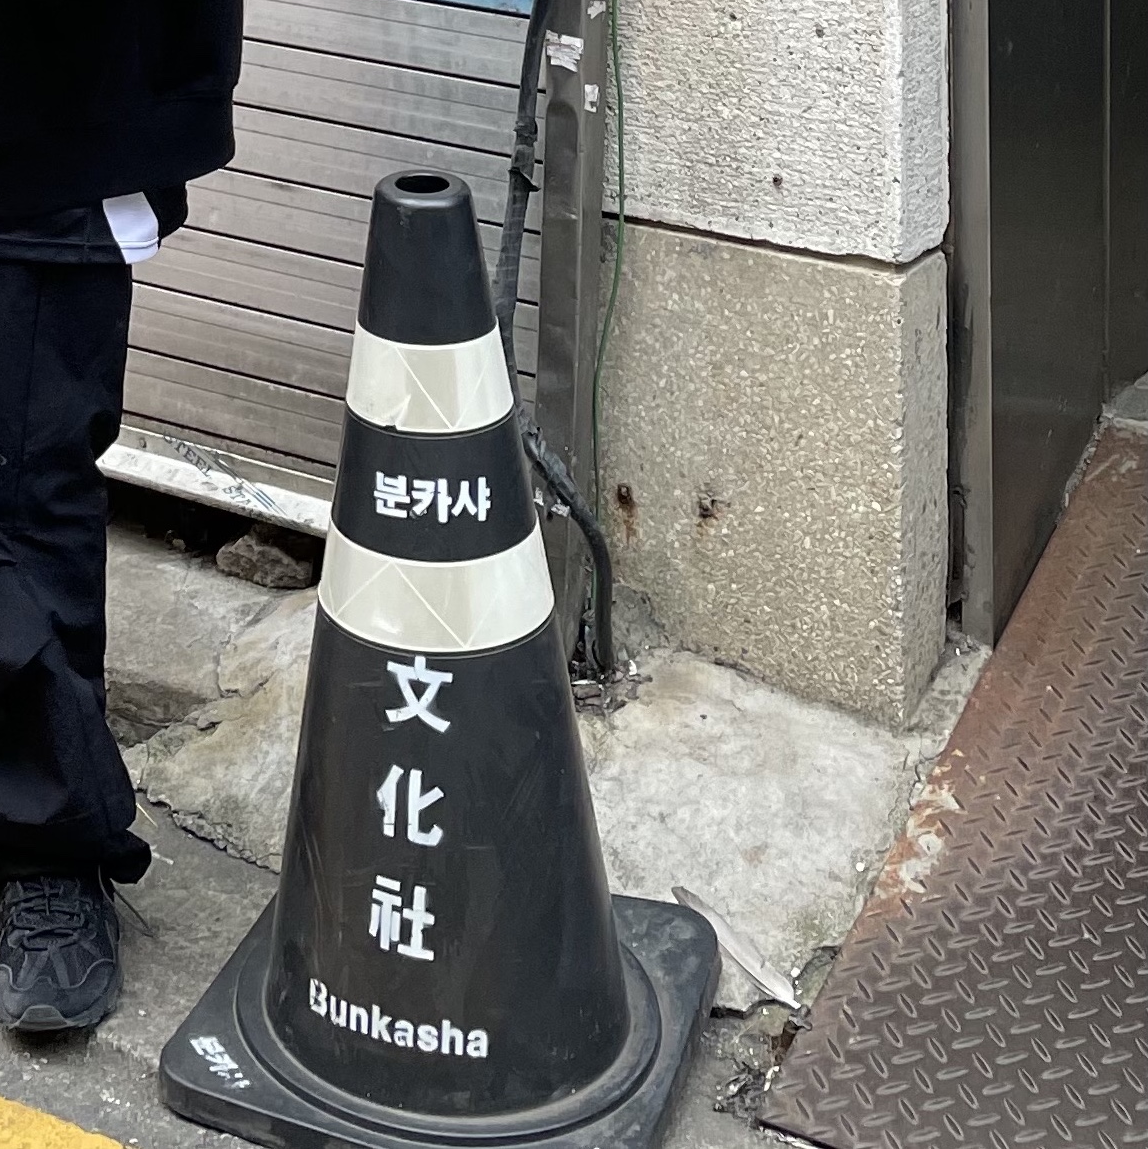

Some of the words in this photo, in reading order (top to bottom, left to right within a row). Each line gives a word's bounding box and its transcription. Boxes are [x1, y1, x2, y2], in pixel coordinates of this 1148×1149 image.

[373, 470, 492, 524] 분카샤
[368, 655, 453, 961] 文化社
[309, 977, 489, 1059] Bunkasha
